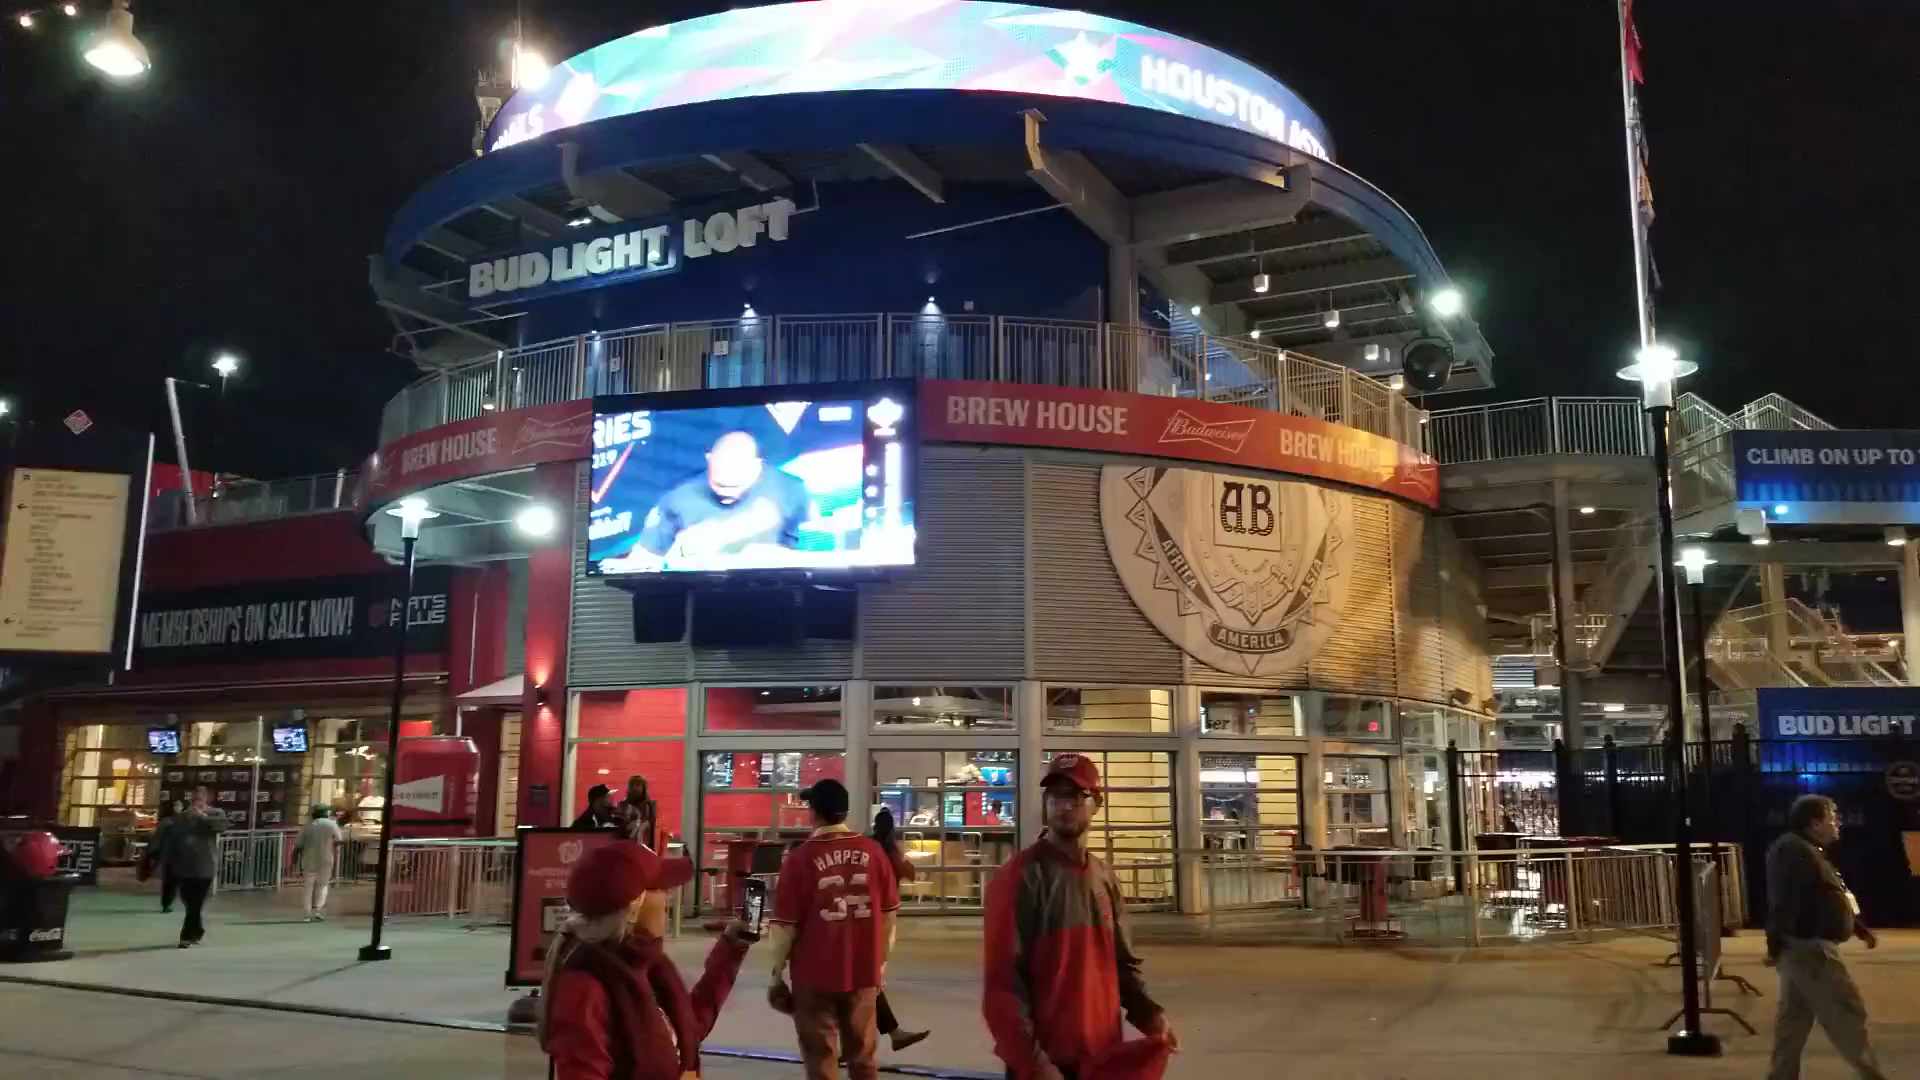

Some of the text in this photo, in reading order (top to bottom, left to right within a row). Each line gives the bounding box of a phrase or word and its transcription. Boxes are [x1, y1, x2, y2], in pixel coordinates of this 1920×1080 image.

[1140, 54, 1285, 142] HOUSTON
[469, 197, 796, 297] BUD LIGHT LOFT
[946, 395, 1129, 436] BREW HOUSE
[1168, 417, 1248, 441] Budweiser
[441, 428, 497, 464] HOUSE
[1280, 428, 1334, 463] BREW
[1746, 447, 1815, 465] CLIMB
[1819, 448, 1849, 465] ON
[1853, 448, 1883, 465] UP
[1886, 448, 1915, 465] TO
[1219, 481, 1275, 537] AB
[1161, 539, 1197, 590] AFRICA
[1301, 558, 1325, 597] ASIA
[141, 596, 355, 648] MEMBERSHIPS ON SALE NOW!
[1216, 628, 1286, 650] AMERICA
[1778, 715, 1835, 736] BUD
[813, 849, 870, 872] HARPER
